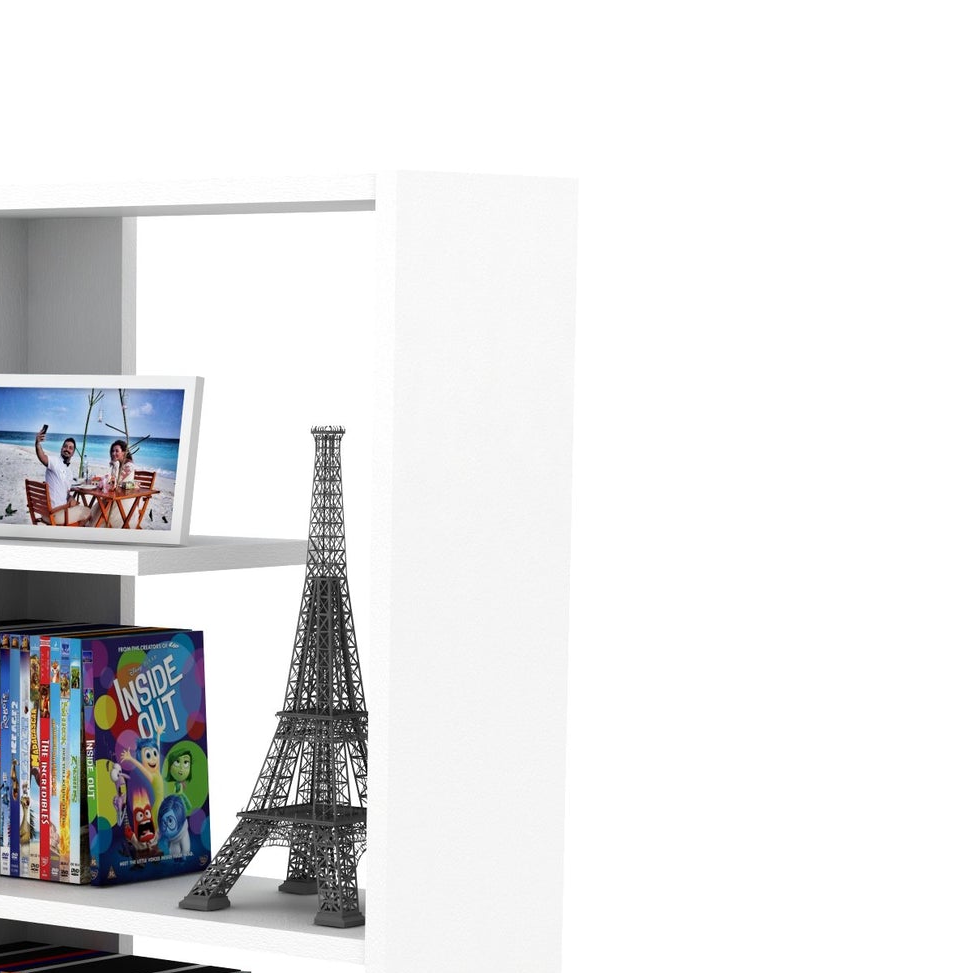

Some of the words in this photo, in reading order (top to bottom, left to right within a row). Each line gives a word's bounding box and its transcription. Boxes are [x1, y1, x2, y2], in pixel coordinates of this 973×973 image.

[113, 654, 183, 721] INSIDE
[137, 689, 180, 739] OUT
[41, 739, 49, 758] THE
[85, 739, 95, 773] INSIDE
[41, 762, 50, 825] INCREDIBLES
[87, 777, 95, 801] OUT
